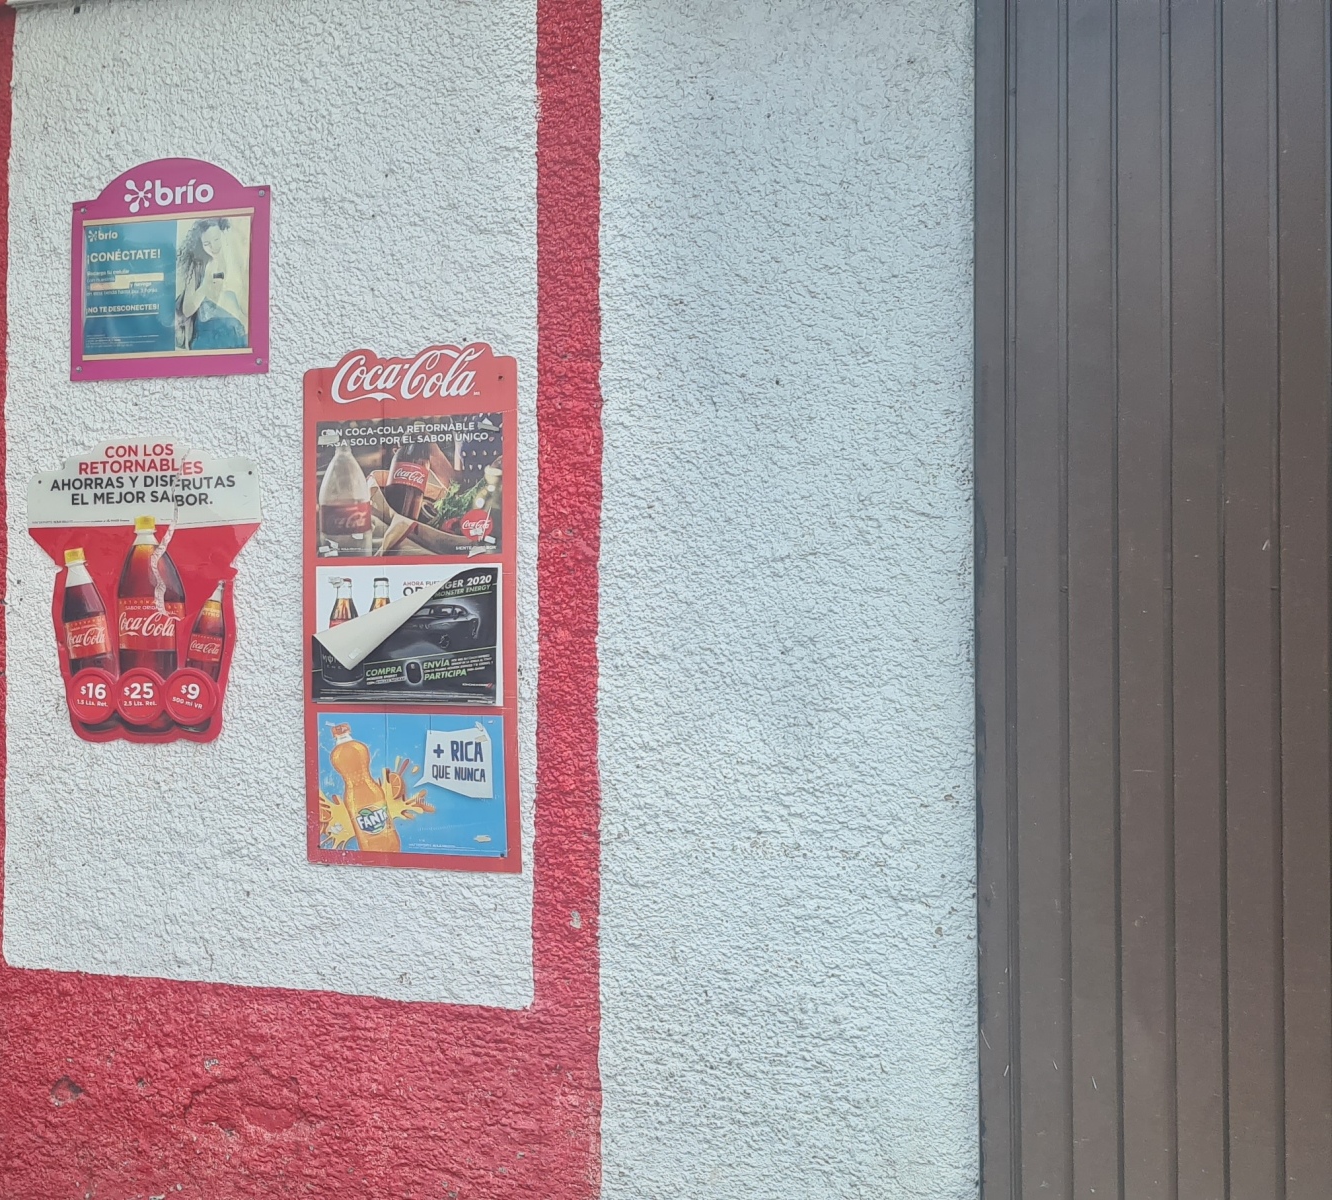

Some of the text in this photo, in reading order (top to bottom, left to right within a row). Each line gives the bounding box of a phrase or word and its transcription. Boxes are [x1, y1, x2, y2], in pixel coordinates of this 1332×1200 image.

[155, 179, 214, 206] brío
[87, 248, 161, 264] ¡CONÉCTATE!
[331, 348, 485, 403] Coca-Cola
[345, 425, 404, 436] COCA-COLA
[406, 421, 475, 433] RETORNABLE
[350, 437, 377, 447] SOLO
[379, 436, 400, 445] POR
[403, 435, 415, 444] EL
[417, 433, 453, 443] SABOR
[105, 443, 174, 459] CON LOS
[79, 458, 204, 475] RETORNABLES
[50, 475, 125, 492] AHORRAS
[129, 475, 139, 488] Y
[71, 493, 89, 506] EL
[93, 491, 145, 505] MEJOR
[466, 575, 492, 587] 2020
[365, 666, 402, 677] COMPRA
[424, 669, 467, 680] PARTICIPA
[80, 683, 106, 699] $16
[124, 683, 154, 699] $25
[180, 683, 200, 699] $9
[451, 740, 484, 762] RICA
[432, 764, 486, 783] QUE NUNCA
